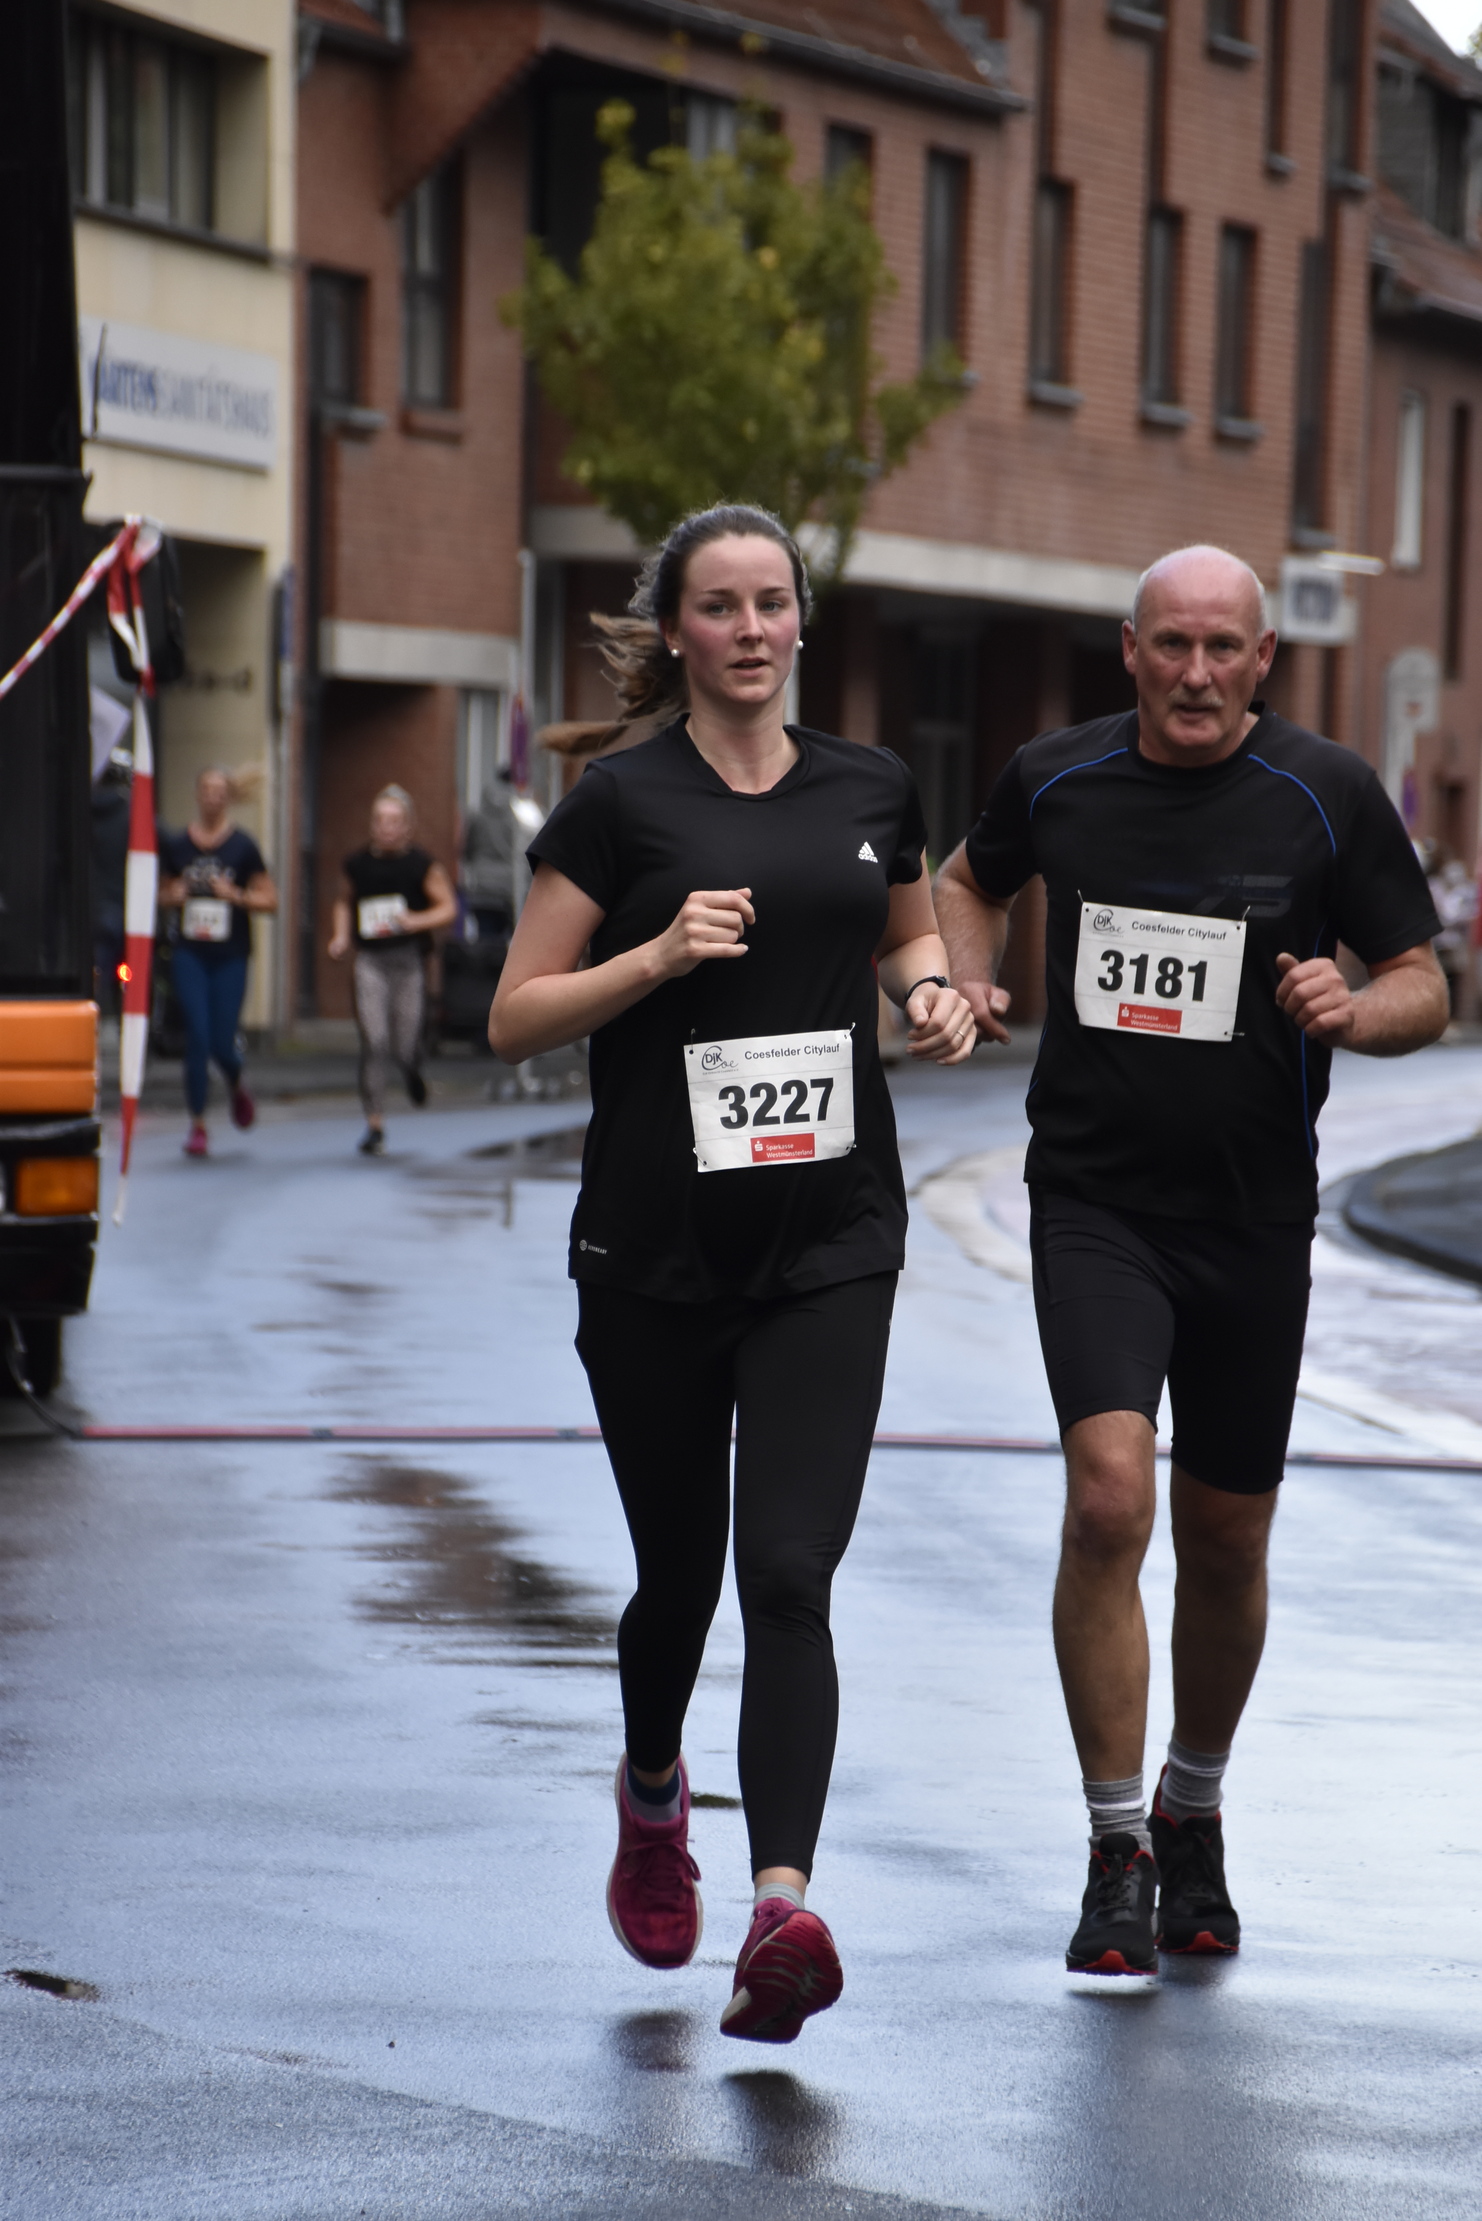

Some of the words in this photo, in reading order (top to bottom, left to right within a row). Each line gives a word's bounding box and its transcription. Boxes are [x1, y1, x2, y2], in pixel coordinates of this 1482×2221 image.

[1131, 920, 1185, 936] Coesfelder
[1187, 928, 1227, 941] Citylauf
[1097, 949, 1208, 1002] 3181
[1131, 1012, 1159, 1022] Sparkasse
[1130, 1019, 1178, 1031] Westmünsterland
[744, 1048, 801, 1060] Coesfelder
[804, 1043, 841, 1055] Citylauf
[718, 1077, 834, 1130] 3227
[765, 1143, 795, 1152] Sparkasse
[766, 1149, 814, 1159] Westmünsterland
